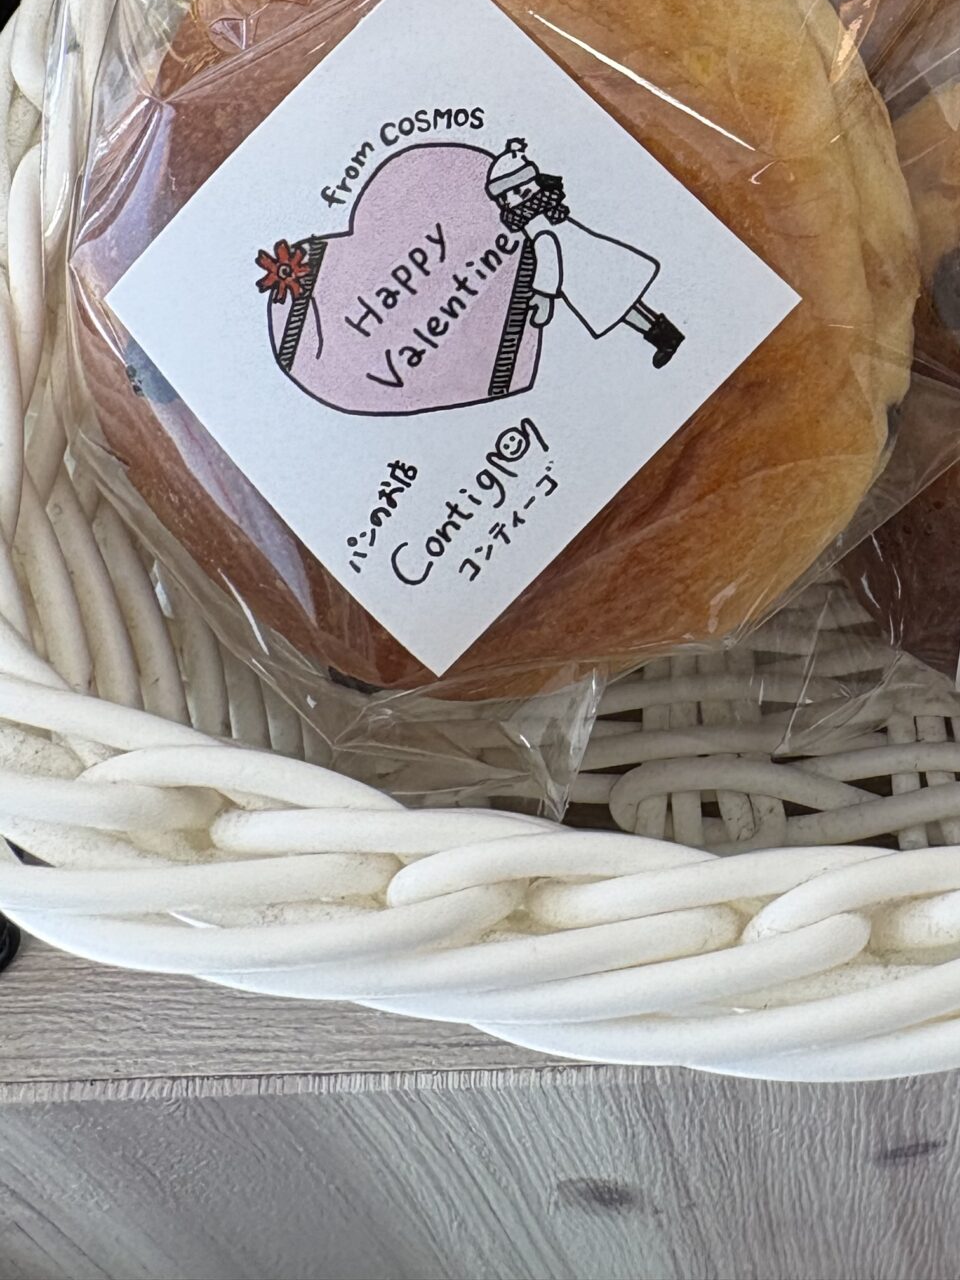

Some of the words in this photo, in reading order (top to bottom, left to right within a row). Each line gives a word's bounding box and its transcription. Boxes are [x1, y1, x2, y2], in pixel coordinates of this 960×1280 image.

[320, 142, 375, 208] from
[379, 107, 485, 147] COSMOS
[344, 222, 446, 337] Happy
[366, 232, 520, 388] Valentine
[347, 460, 418, 573] パンのお店
[459, 460, 558, 582] コンティーゴ
